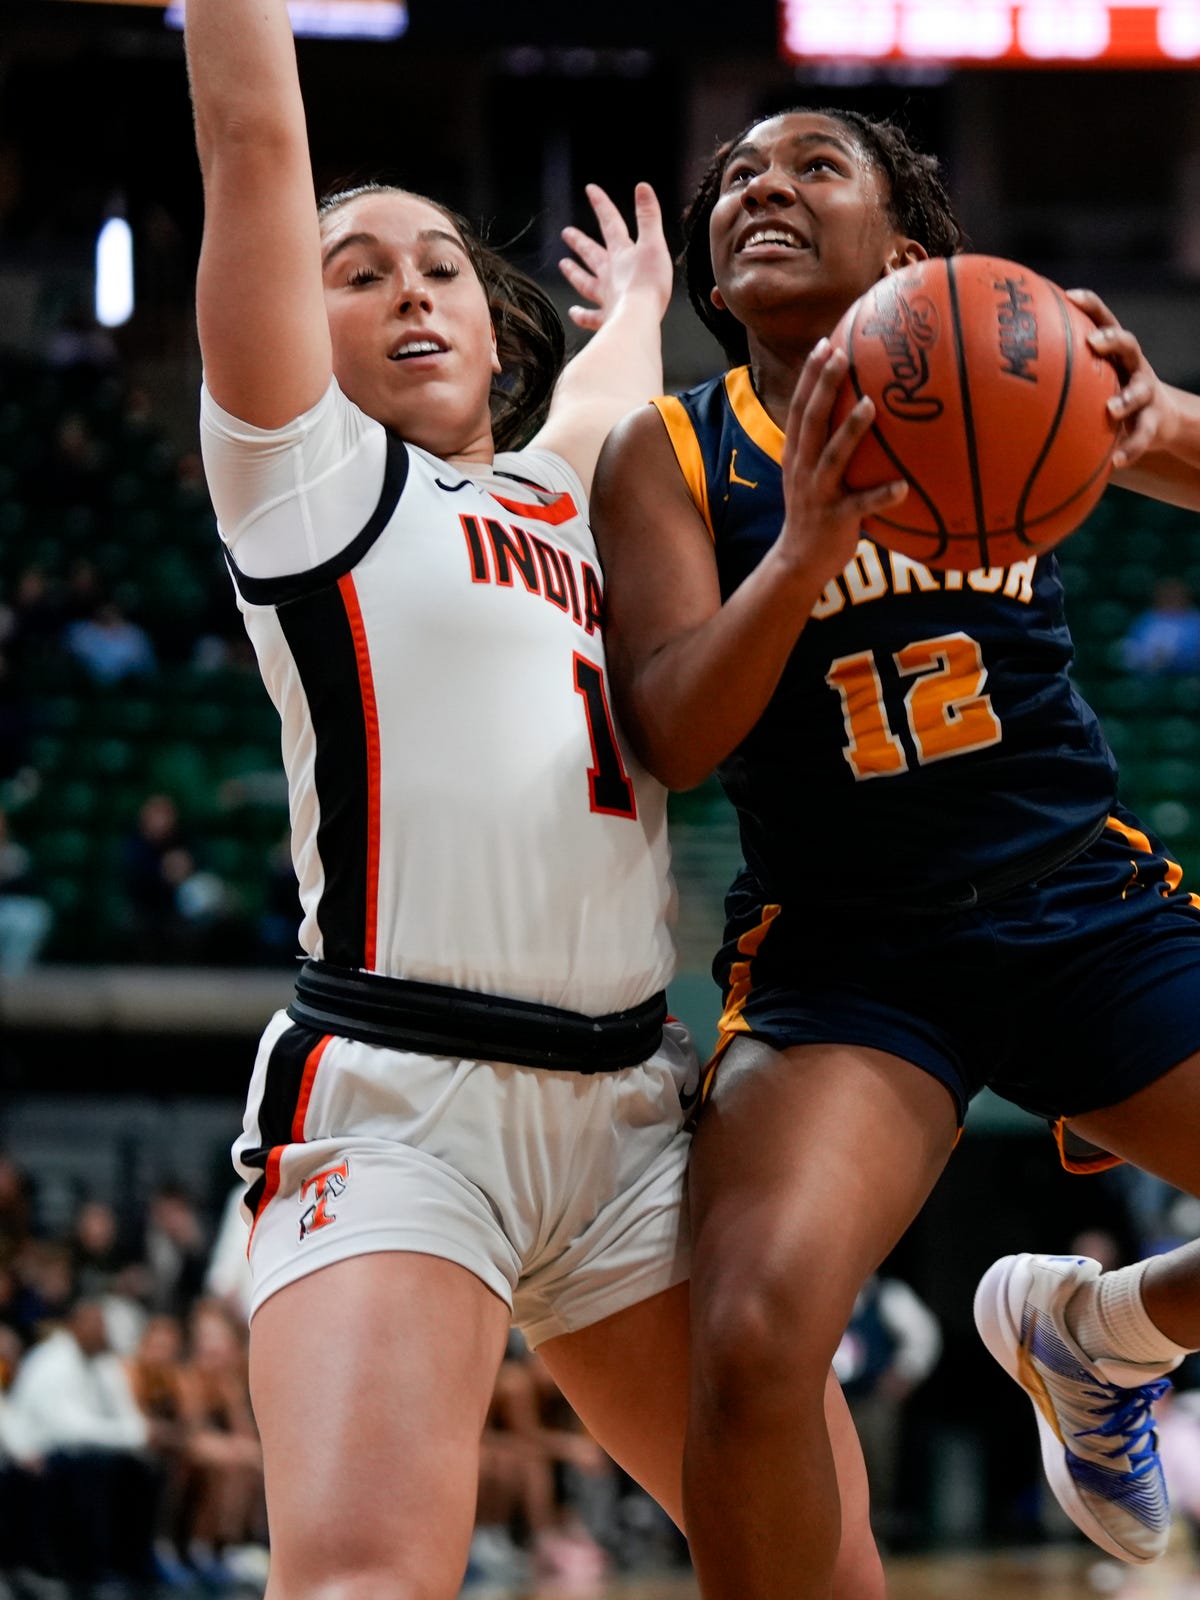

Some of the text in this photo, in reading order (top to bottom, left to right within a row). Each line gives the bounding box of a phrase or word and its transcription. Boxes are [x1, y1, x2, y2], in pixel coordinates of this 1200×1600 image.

[458, 513, 604, 636] INDIA
[572, 649, 637, 821] 1
[825, 631, 1002, 782] 12
